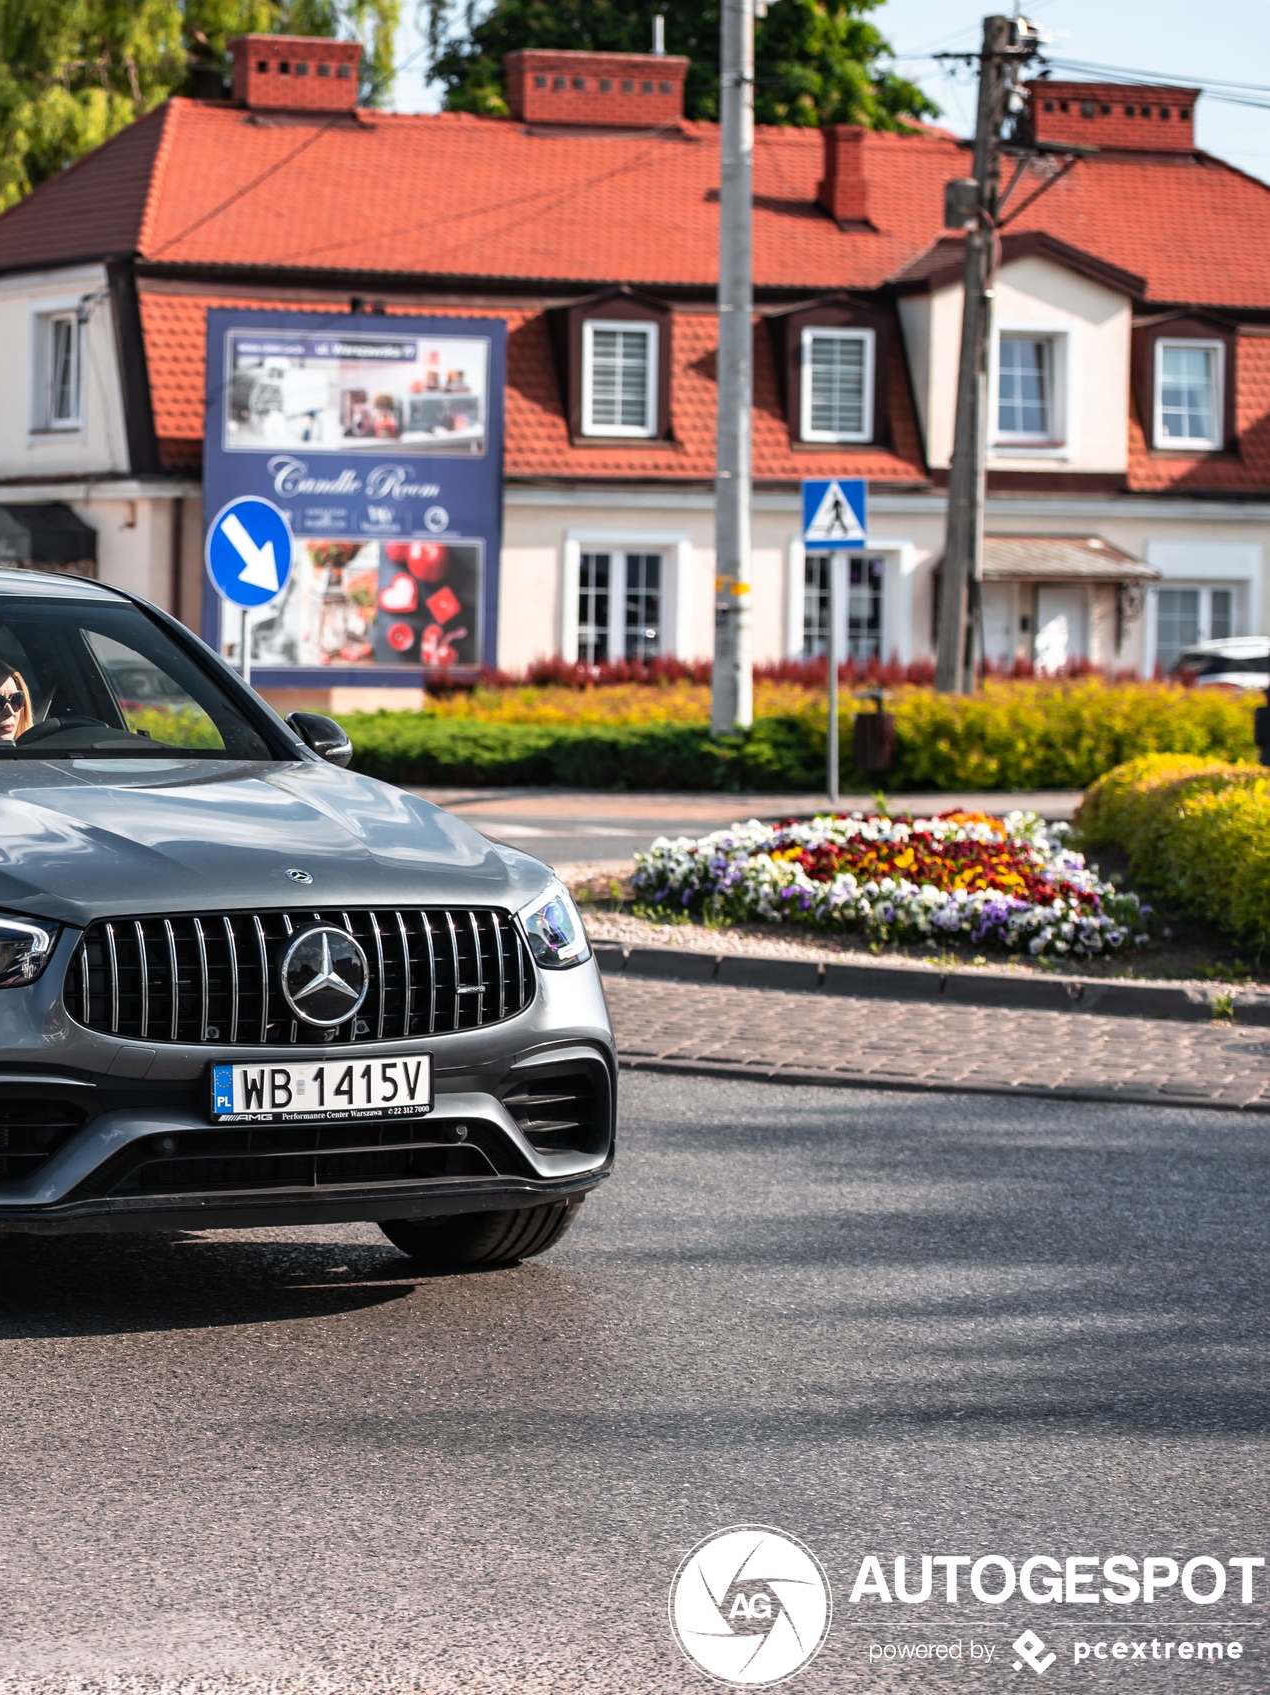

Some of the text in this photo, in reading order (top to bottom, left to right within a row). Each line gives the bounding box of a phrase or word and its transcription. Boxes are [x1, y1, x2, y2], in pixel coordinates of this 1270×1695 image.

[267, 455, 441, 501] Candle Room
[241, 1060, 422, 1110] WB 1415V
[217, 1096, 232, 1107] PL
[235, 1113, 273, 1121] AMG
[326, 1111, 349, 1119] Center
[350, 1109, 383, 1118] Warszawa
[393, 1107, 402, 1115] 22
[402, 1106, 413, 1114] 312
[414, 1105, 430, 1113] 7000
